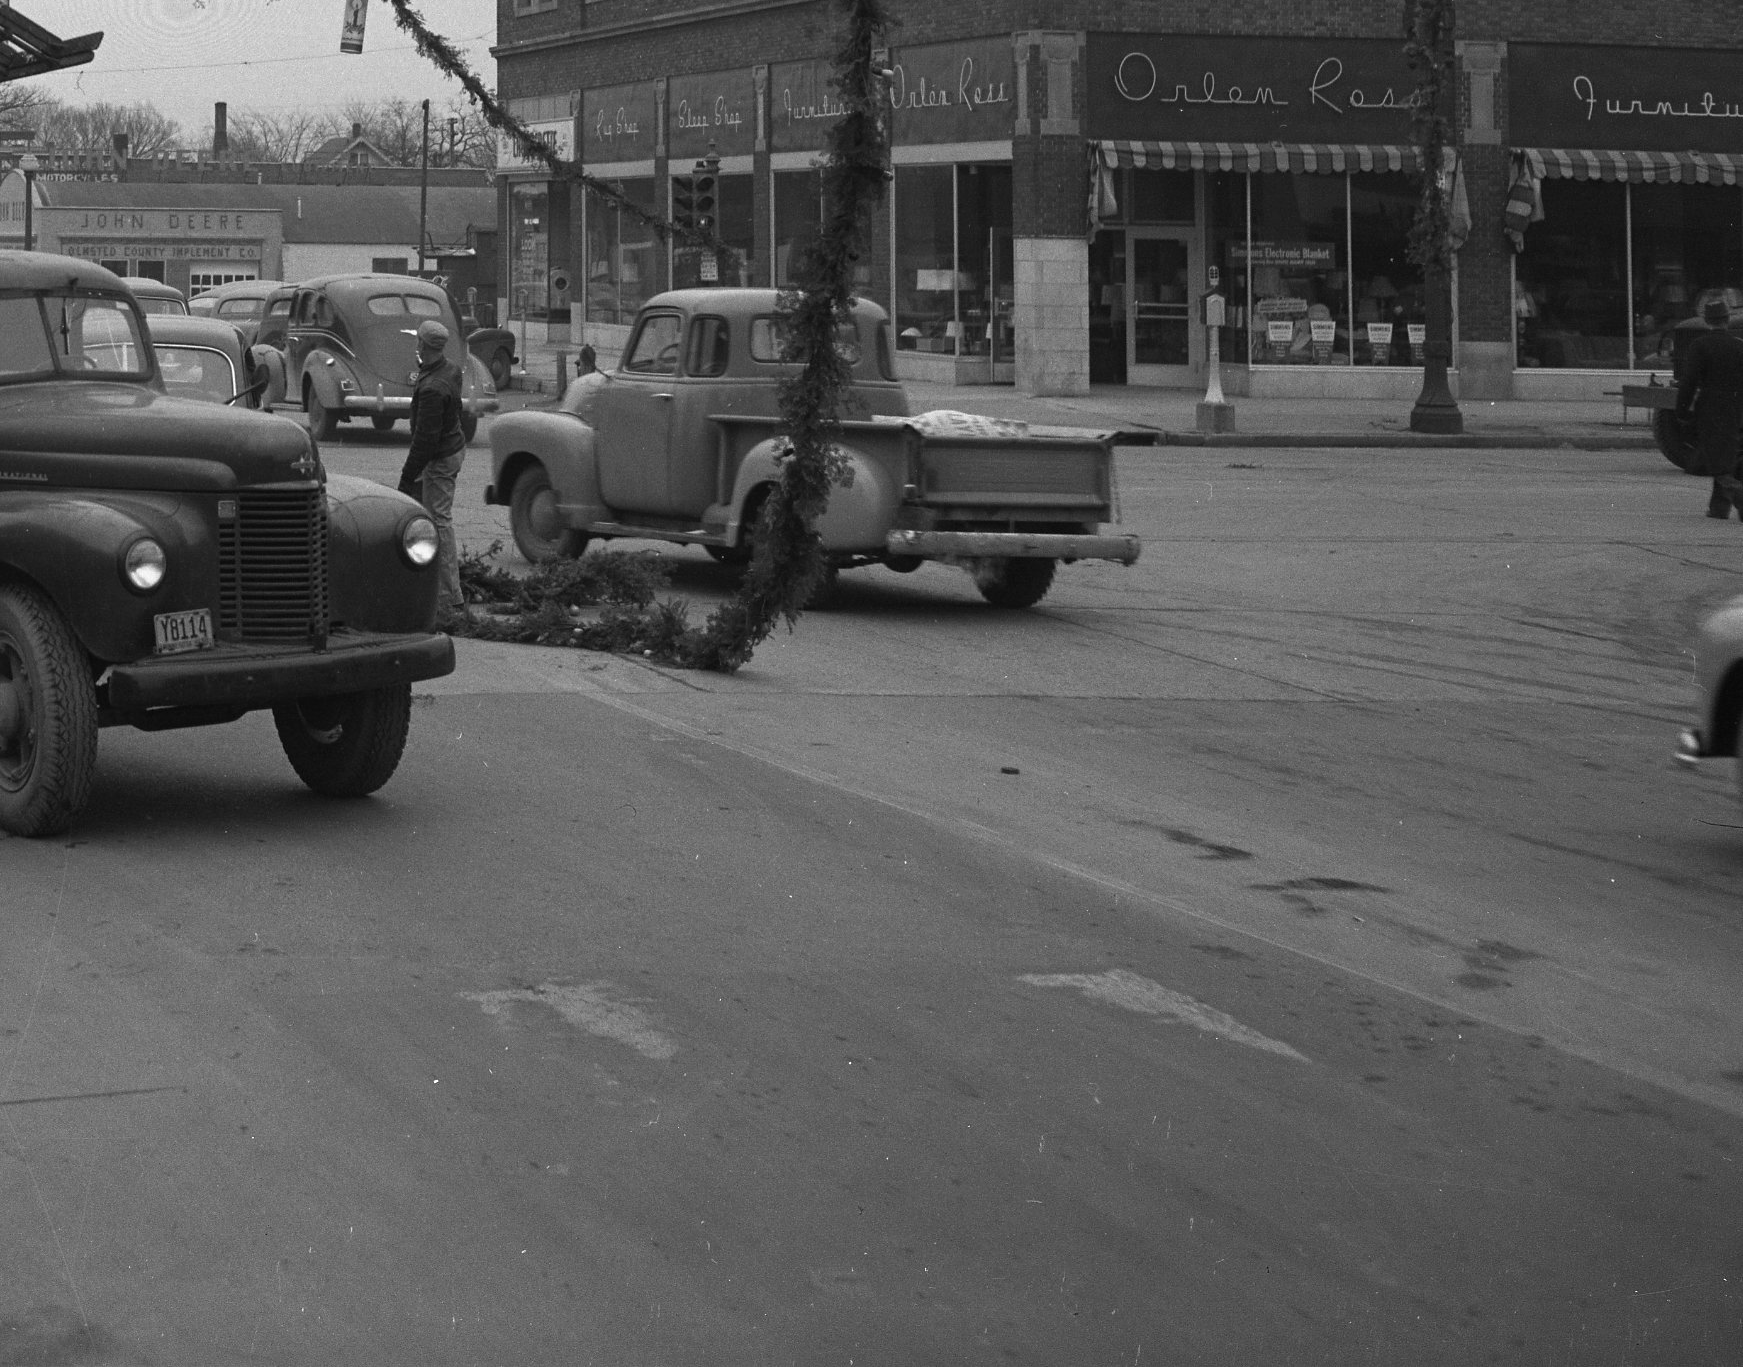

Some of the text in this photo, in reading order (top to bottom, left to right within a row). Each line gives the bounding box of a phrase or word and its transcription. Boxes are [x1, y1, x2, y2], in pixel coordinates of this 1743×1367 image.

[959, 57, 1009, 112] Ross
[678, 94, 743, 136] Sleep Shop
[80, 213, 244, 230] JOHN DEERE
[68, 246, 116, 257] OLMSTED
[123, 246, 165, 257] COUNTY
[172, 247, 230, 258] IMPLEMENT
[1265, 246, 1301, 259] Electronic
[1302, 246, 1330, 260] Blanket
[160, 615, 207, 643] Y8114
